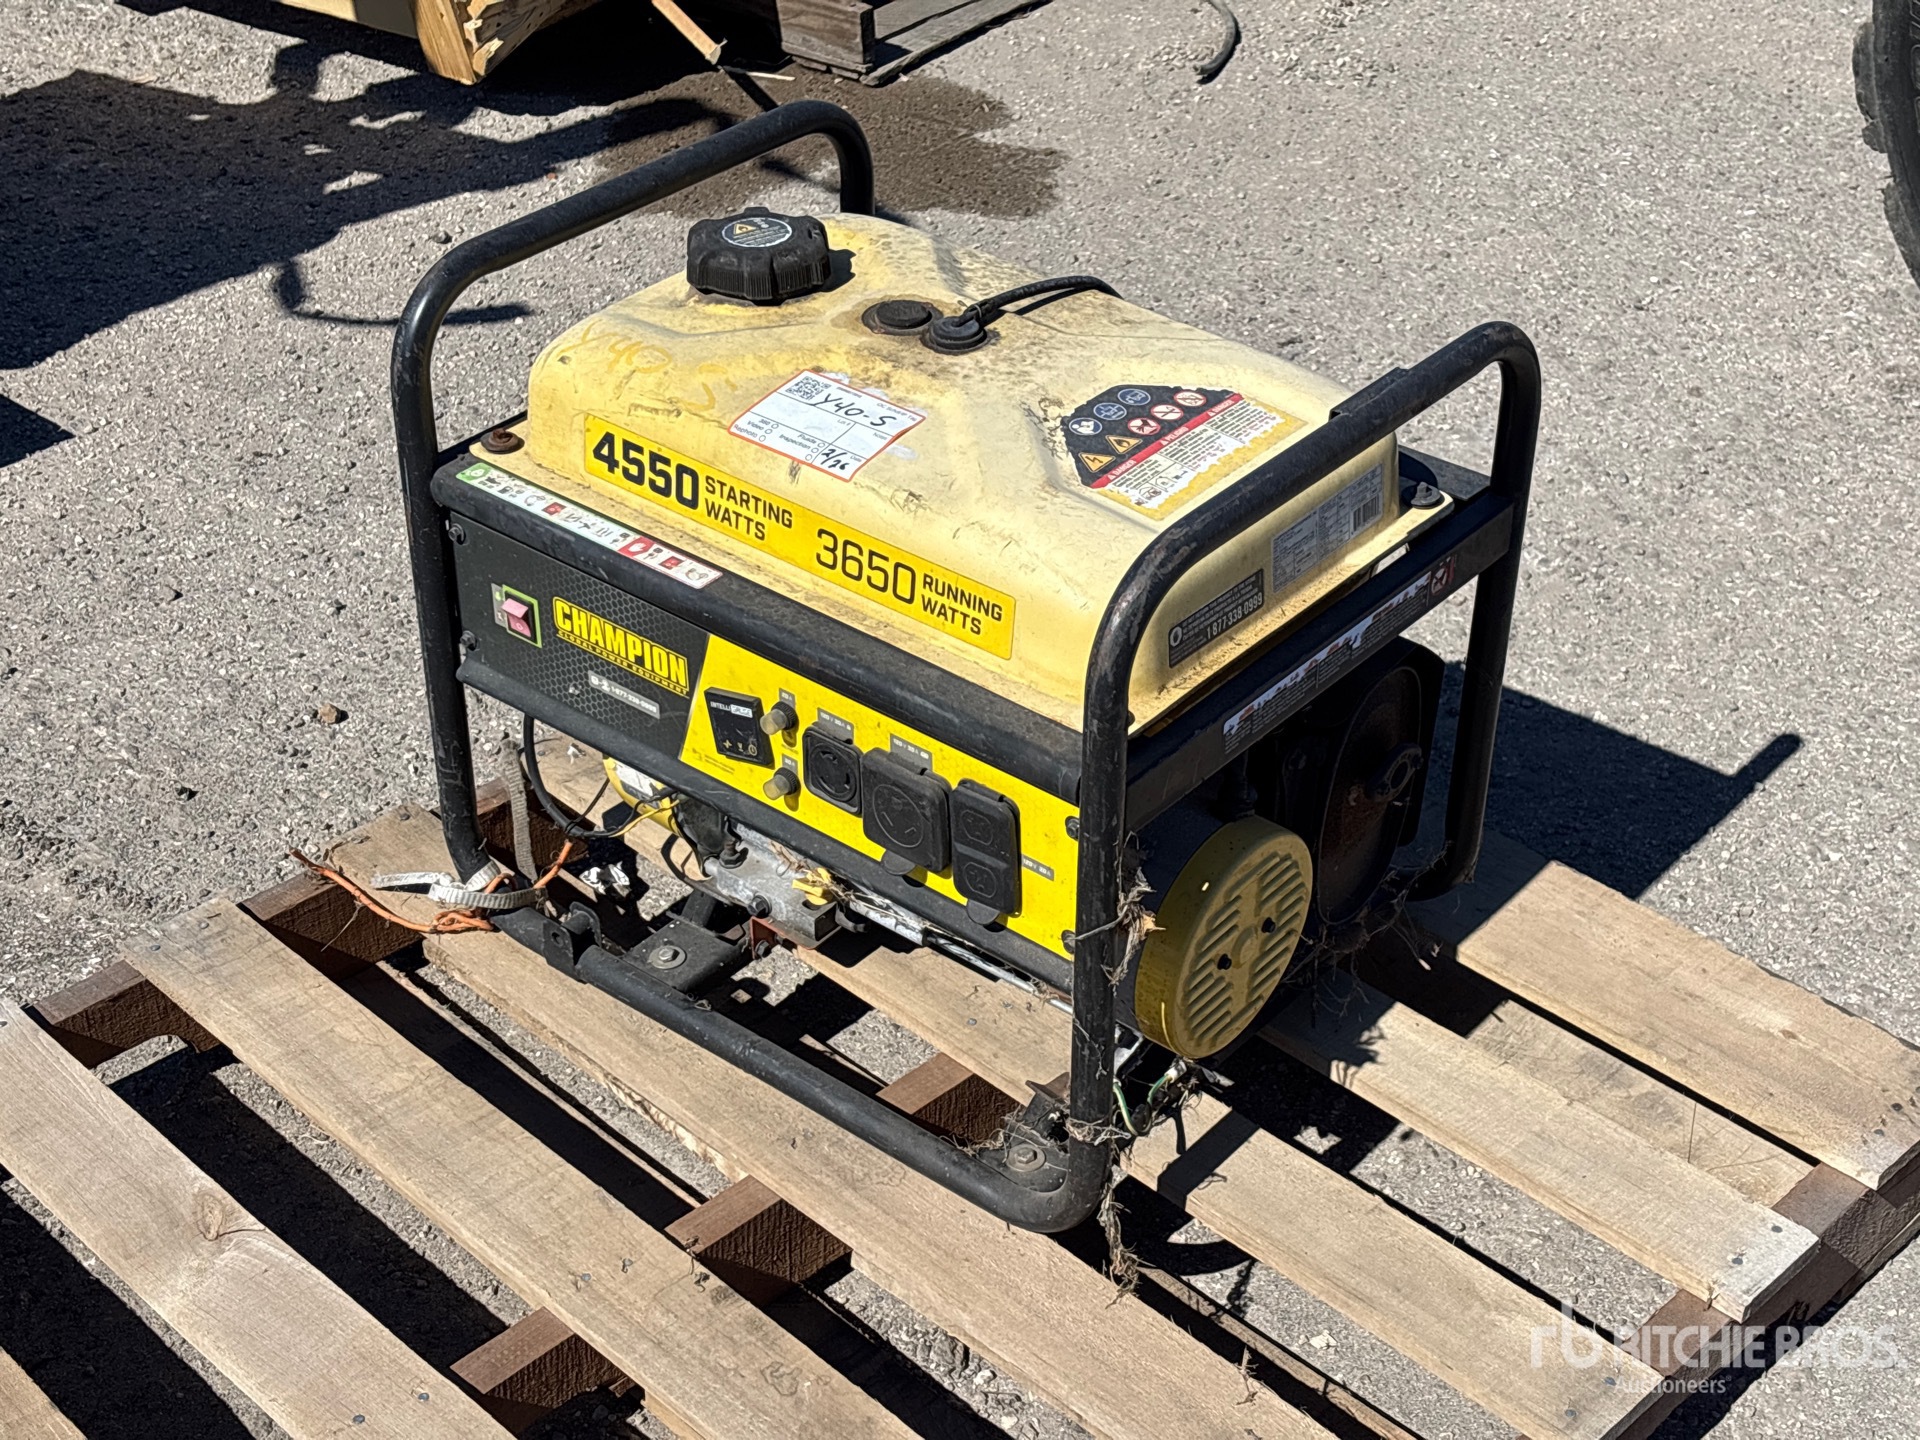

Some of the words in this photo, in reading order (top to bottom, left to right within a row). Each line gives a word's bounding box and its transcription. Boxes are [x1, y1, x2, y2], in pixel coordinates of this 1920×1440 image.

[592, 431, 700, 511] 4550
[704, 475, 793, 529] STARTING
[704, 497, 766, 541] WATTS
[816, 528, 916, 605] 3650
[920, 593, 982, 636] WATTS
[922, 572, 1003, 622] RUNNING
[554, 597, 688, 690] CHAMPION
[558, 630, 594, 652] GLOBAL
[595, 648, 629, 668] POWER
[631, 665, 687, 696] EQUIPMENT
